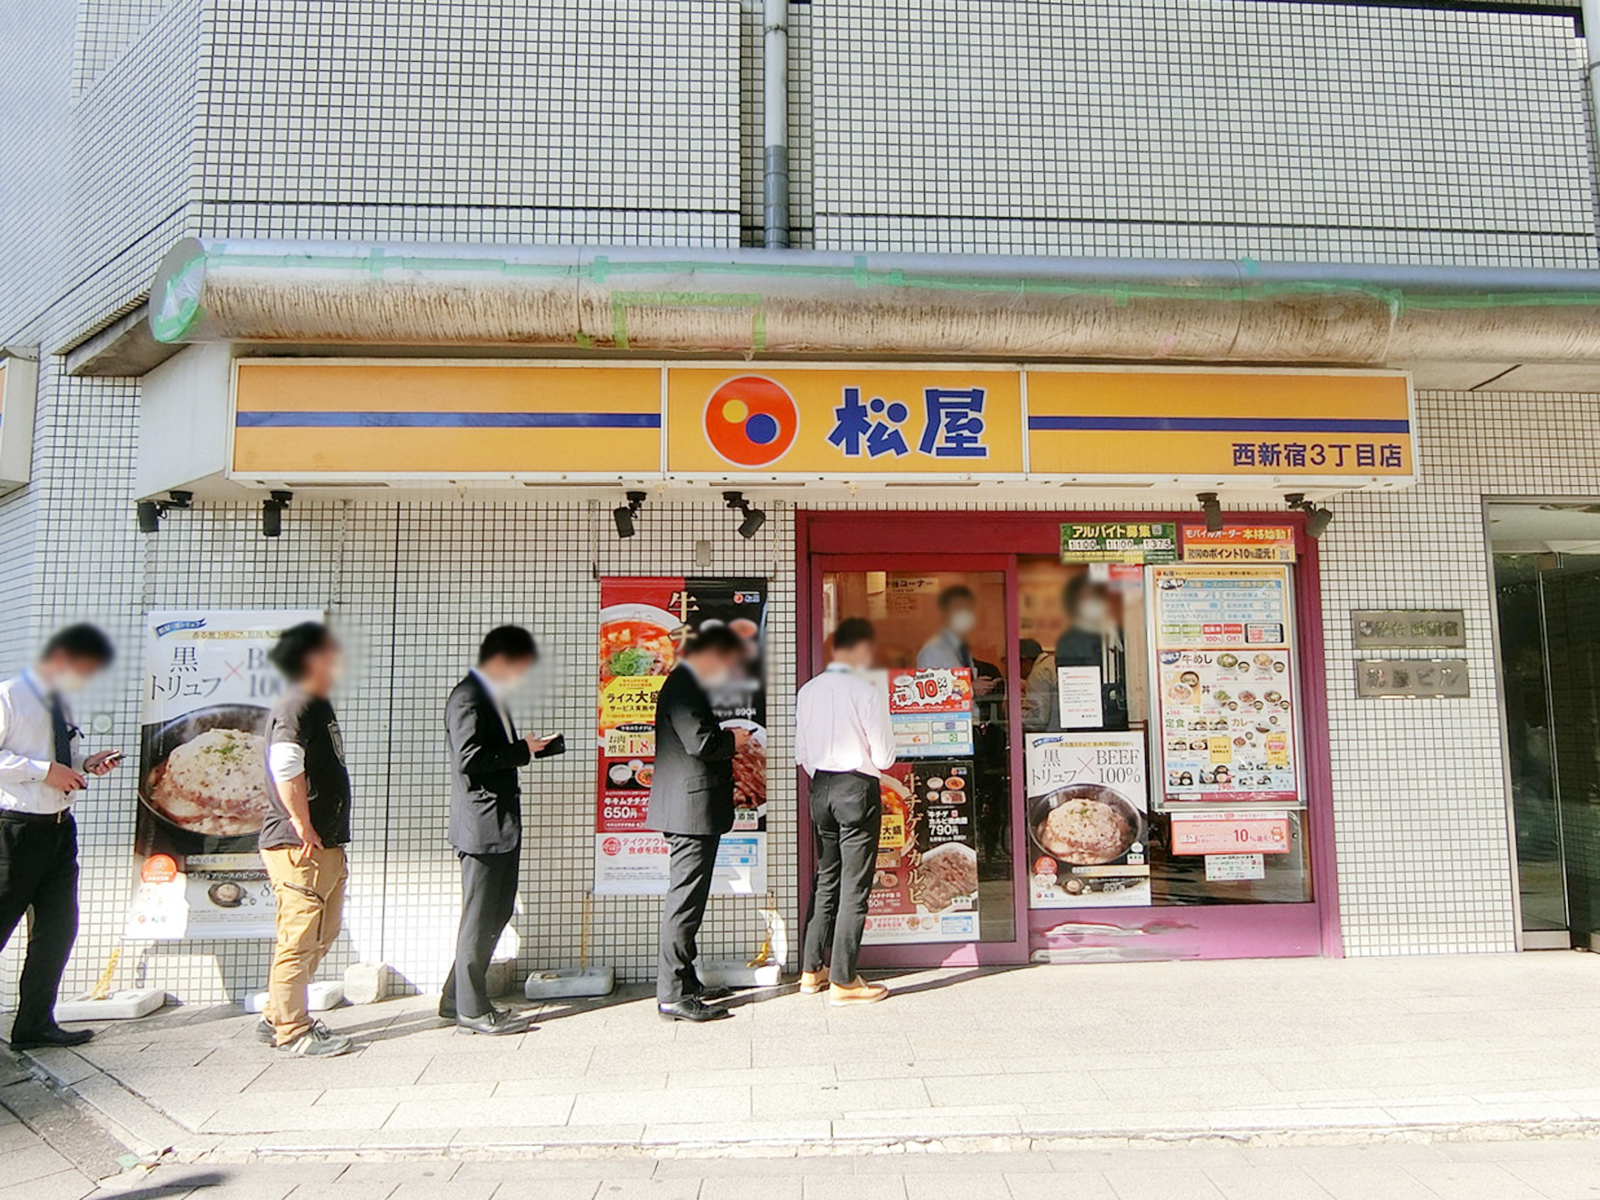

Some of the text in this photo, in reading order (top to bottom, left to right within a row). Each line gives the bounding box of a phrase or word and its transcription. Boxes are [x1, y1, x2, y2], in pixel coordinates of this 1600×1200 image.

[828, 387, 987, 457] 松屋
[1232, 442, 1402, 467] 西新宿3丁目店
[1072, 524, 1151, 538] アルバイト募集
[170, 646, 198, 672] 黒
[1182, 653, 1213, 665] 牛めし
[151, 675, 222, 701] トリュフ
[1165, 718, 1185, 728] 定食
[1231, 718, 1255, 727] カレー
[1042, 749, 1061, 767] 黒
[1096, 749, 1140, 765] BEEF
[1031, 768, 1077, 786] トリュフ
[1099, 767, 1141, 784] 100%
